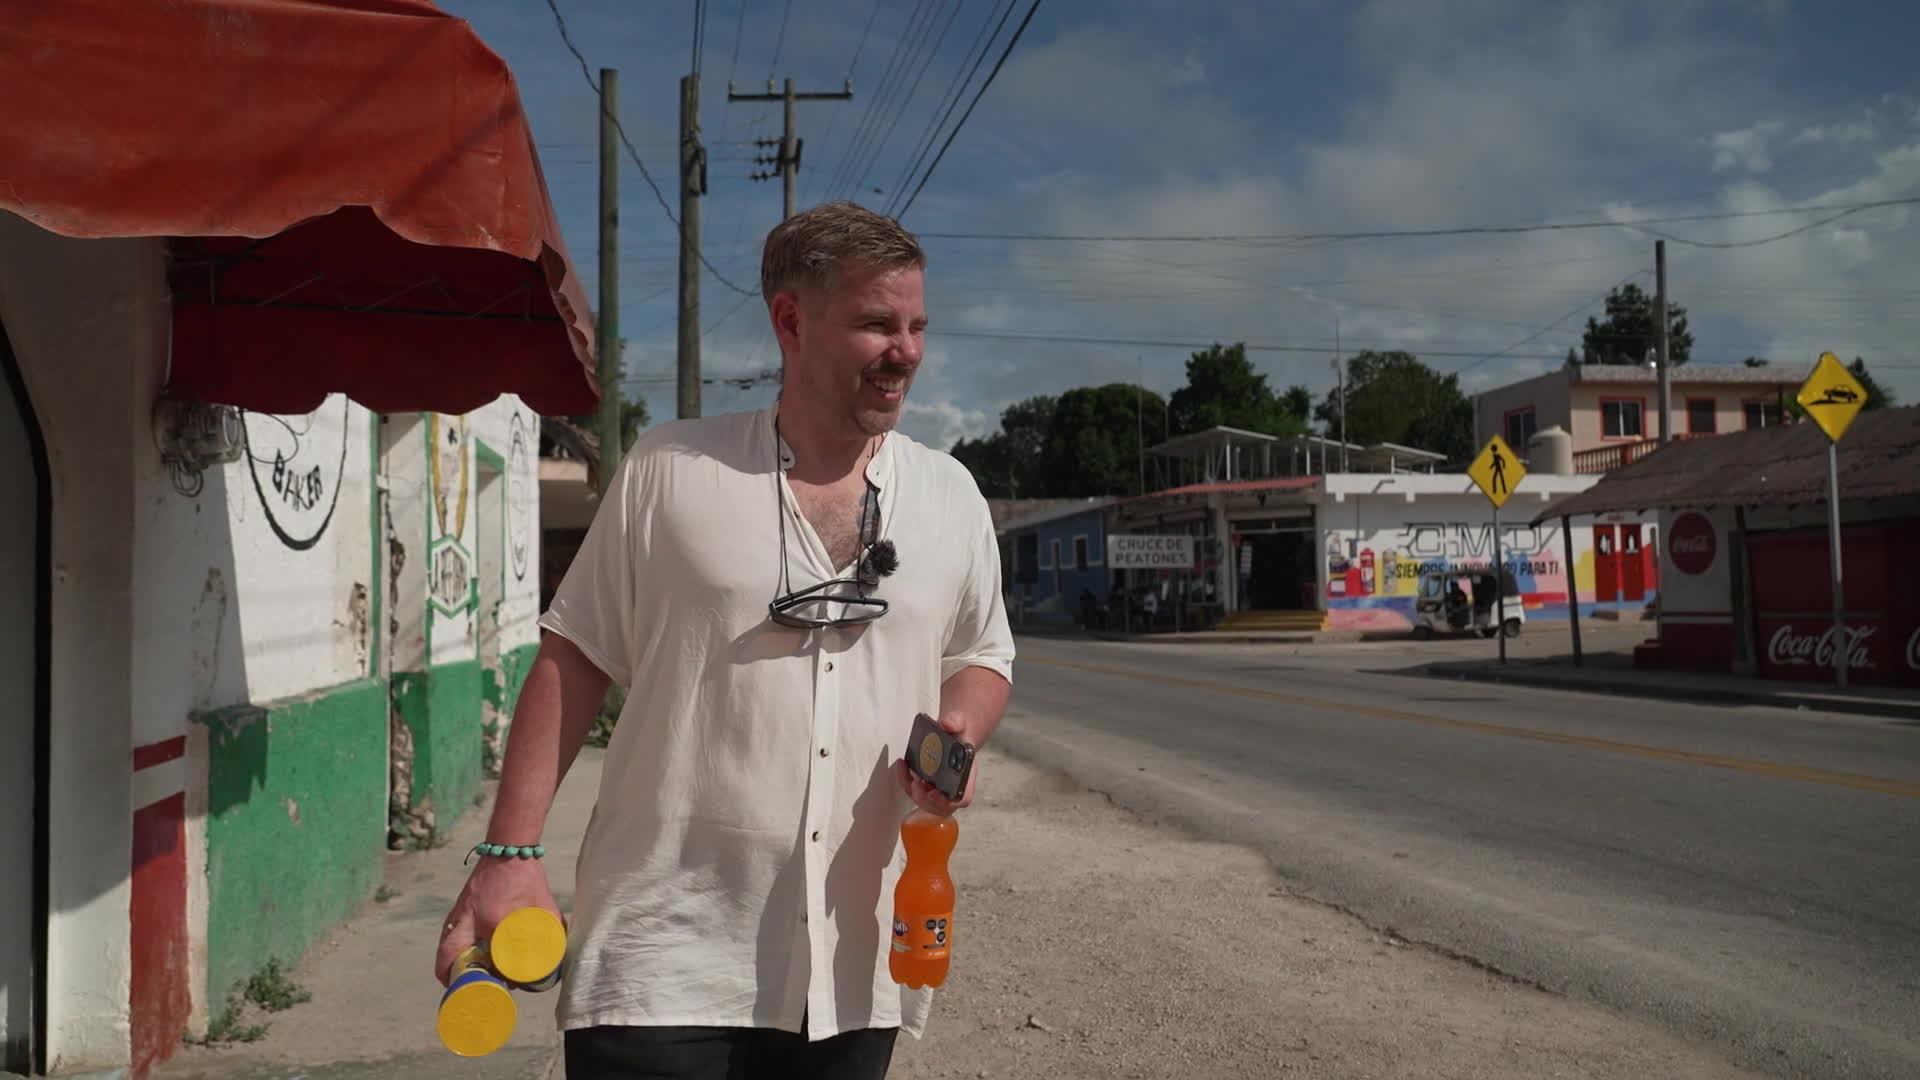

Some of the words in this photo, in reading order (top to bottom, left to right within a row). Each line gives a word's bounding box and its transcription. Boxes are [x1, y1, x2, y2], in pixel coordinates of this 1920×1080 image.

[1118, 537, 1163, 550] CRUCE
[1166, 537, 1185, 550] DE
[1115, 552, 1187, 564] PEATONES
